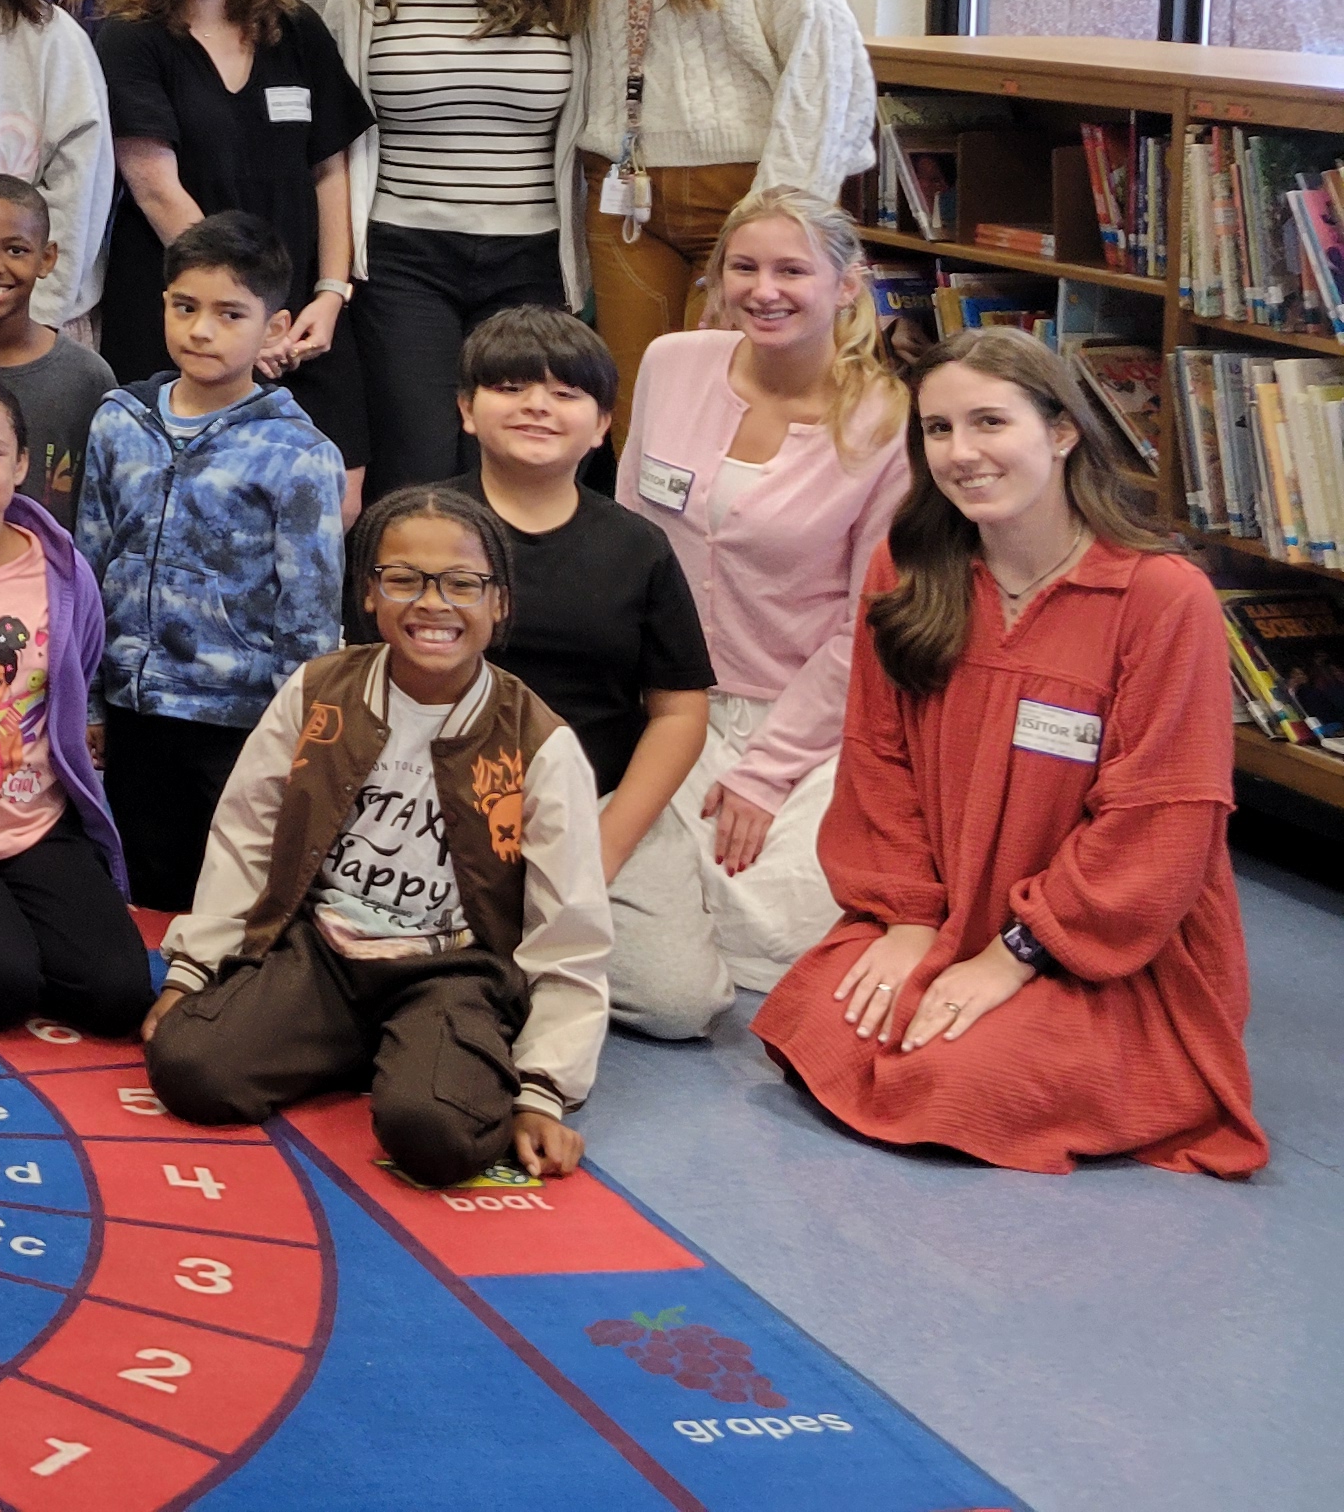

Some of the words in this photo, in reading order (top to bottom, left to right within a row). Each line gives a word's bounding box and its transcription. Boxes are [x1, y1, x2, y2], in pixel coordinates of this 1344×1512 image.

[1017, 717, 1069, 737] ISITOR
[25, 1017, 83, 1045] 6
[116, 1087, 169, 1116] 5
[162, 1164, 226, 1200] 4
[439, 1191, 554, 1213] boat
[173, 1257, 234, 1295] 3
[117, 1347, 193, 1395] 2
[673, 1408, 855, 1443] grapes
[29, 1436, 93, 1477] 1
